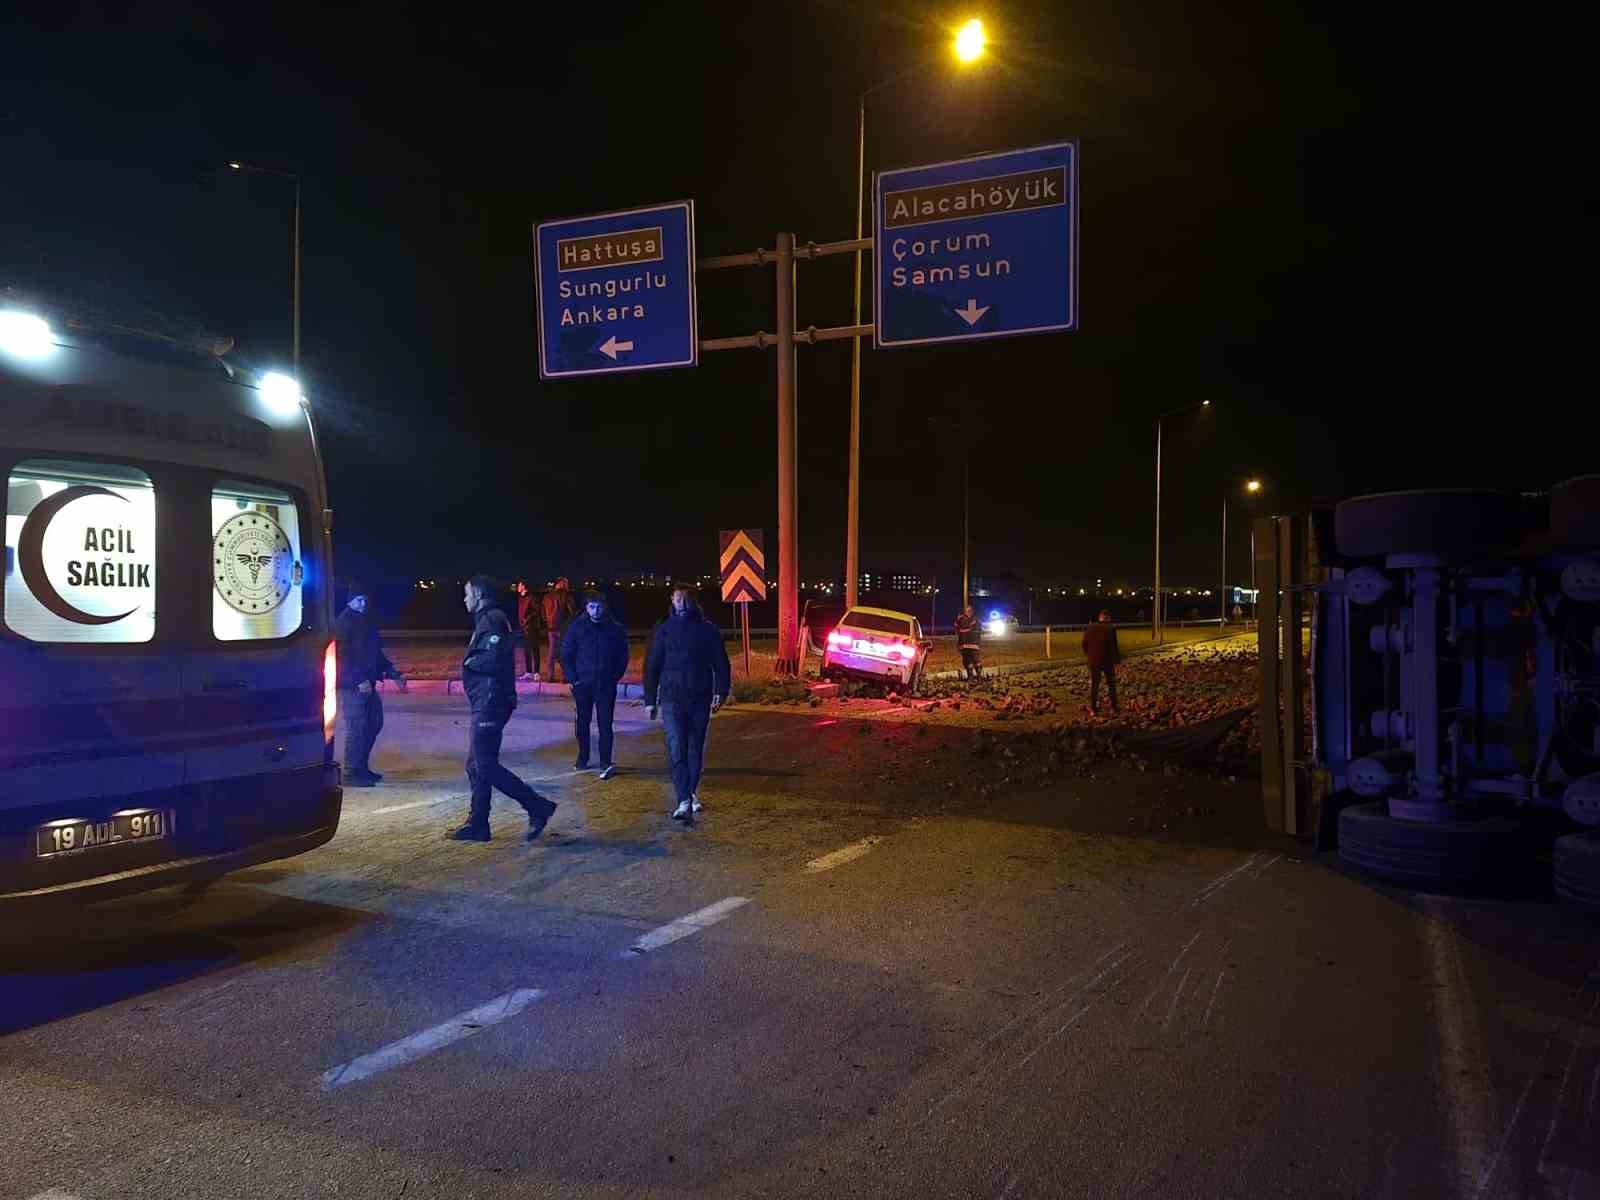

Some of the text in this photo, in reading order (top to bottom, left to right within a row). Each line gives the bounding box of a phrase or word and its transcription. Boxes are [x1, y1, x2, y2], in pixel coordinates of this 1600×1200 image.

[892, 178, 1058, 220] Alacahöyük
[564, 239, 656, 264] Hattuşa
[891, 231, 992, 262] Çorum
[560, 271, 667, 298] Sungurlu
[891, 257, 1012, 287] Samsun
[561, 304, 645, 326] Ankara
[84, 523, 135, 554] ACİL
[67, 556, 150, 588] SAĞLIK
[53, 827, 75, 850] 19
[131, 814, 161, 837] 911
